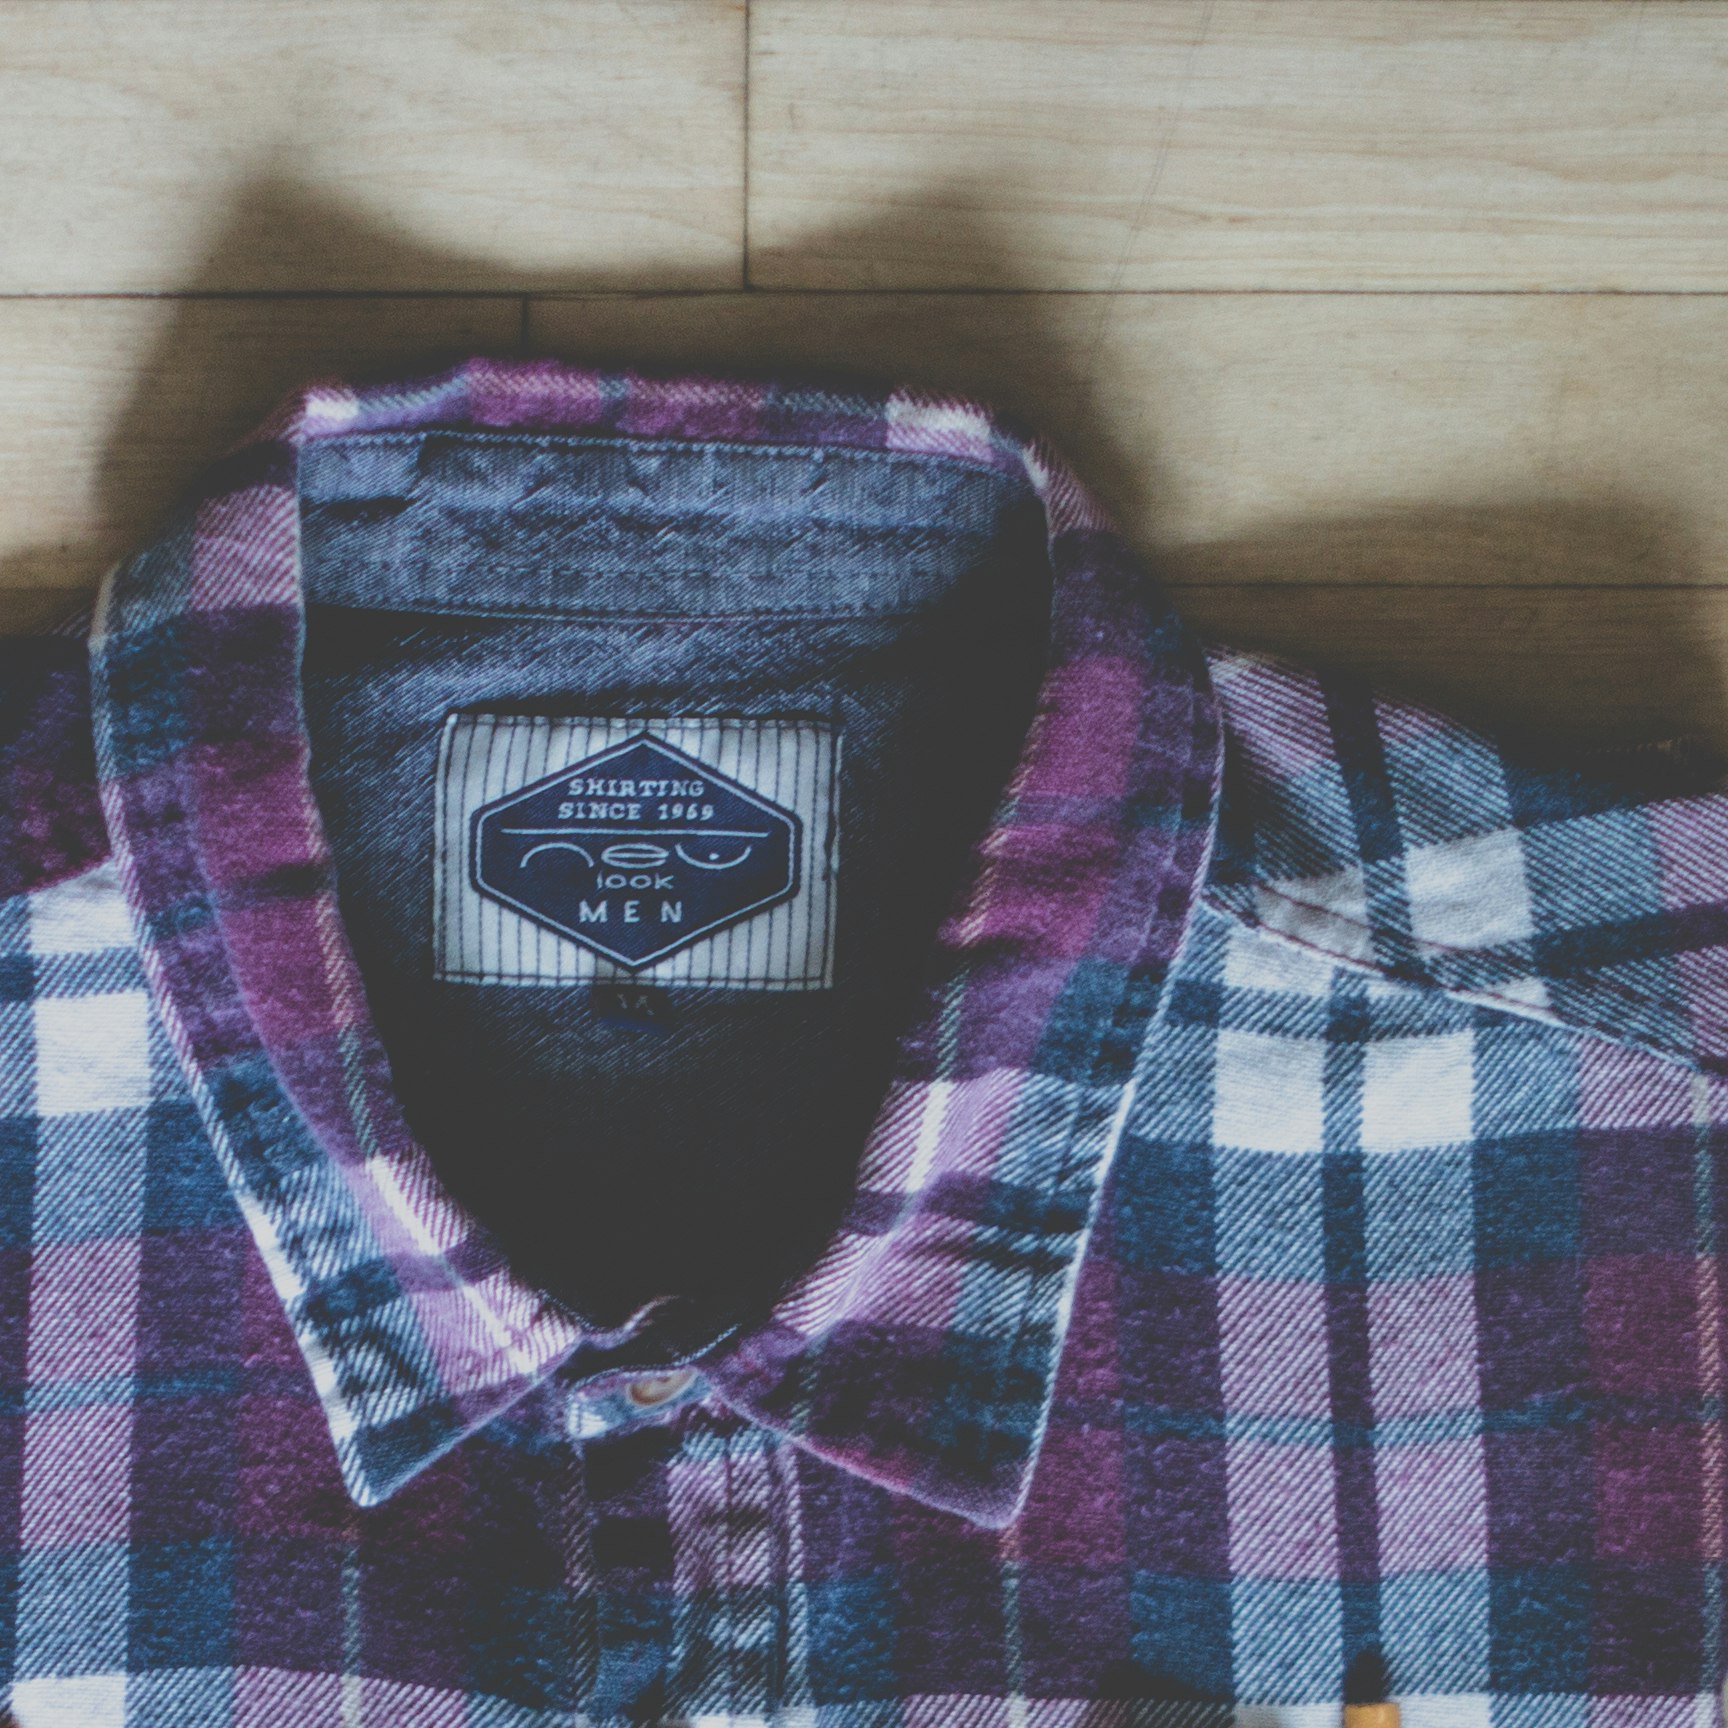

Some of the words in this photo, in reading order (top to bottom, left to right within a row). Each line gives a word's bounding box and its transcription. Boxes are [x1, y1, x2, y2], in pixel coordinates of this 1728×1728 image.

[567, 777, 705, 798] SHIRTING
[557, 801, 642, 821] SINCE
[657, 802, 715, 821] 1969
[596, 870, 675, 890] look
[578, 899, 683, 924] MEN
